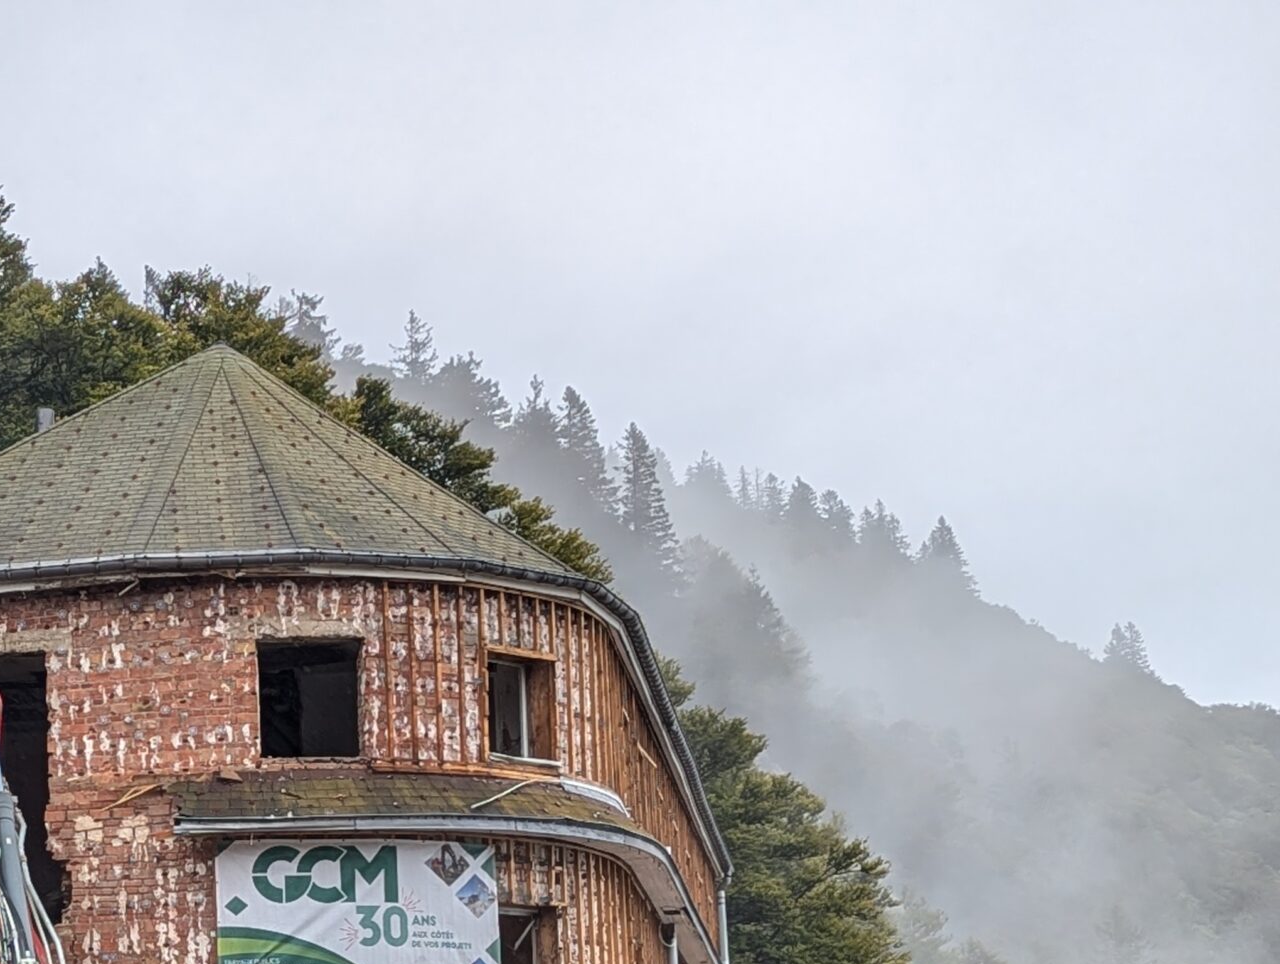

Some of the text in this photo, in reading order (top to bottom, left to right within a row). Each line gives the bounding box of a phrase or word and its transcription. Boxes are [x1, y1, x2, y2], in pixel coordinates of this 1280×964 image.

[252, 845, 399, 904] GCM
[355, 905, 437, 947] 30 ANS
